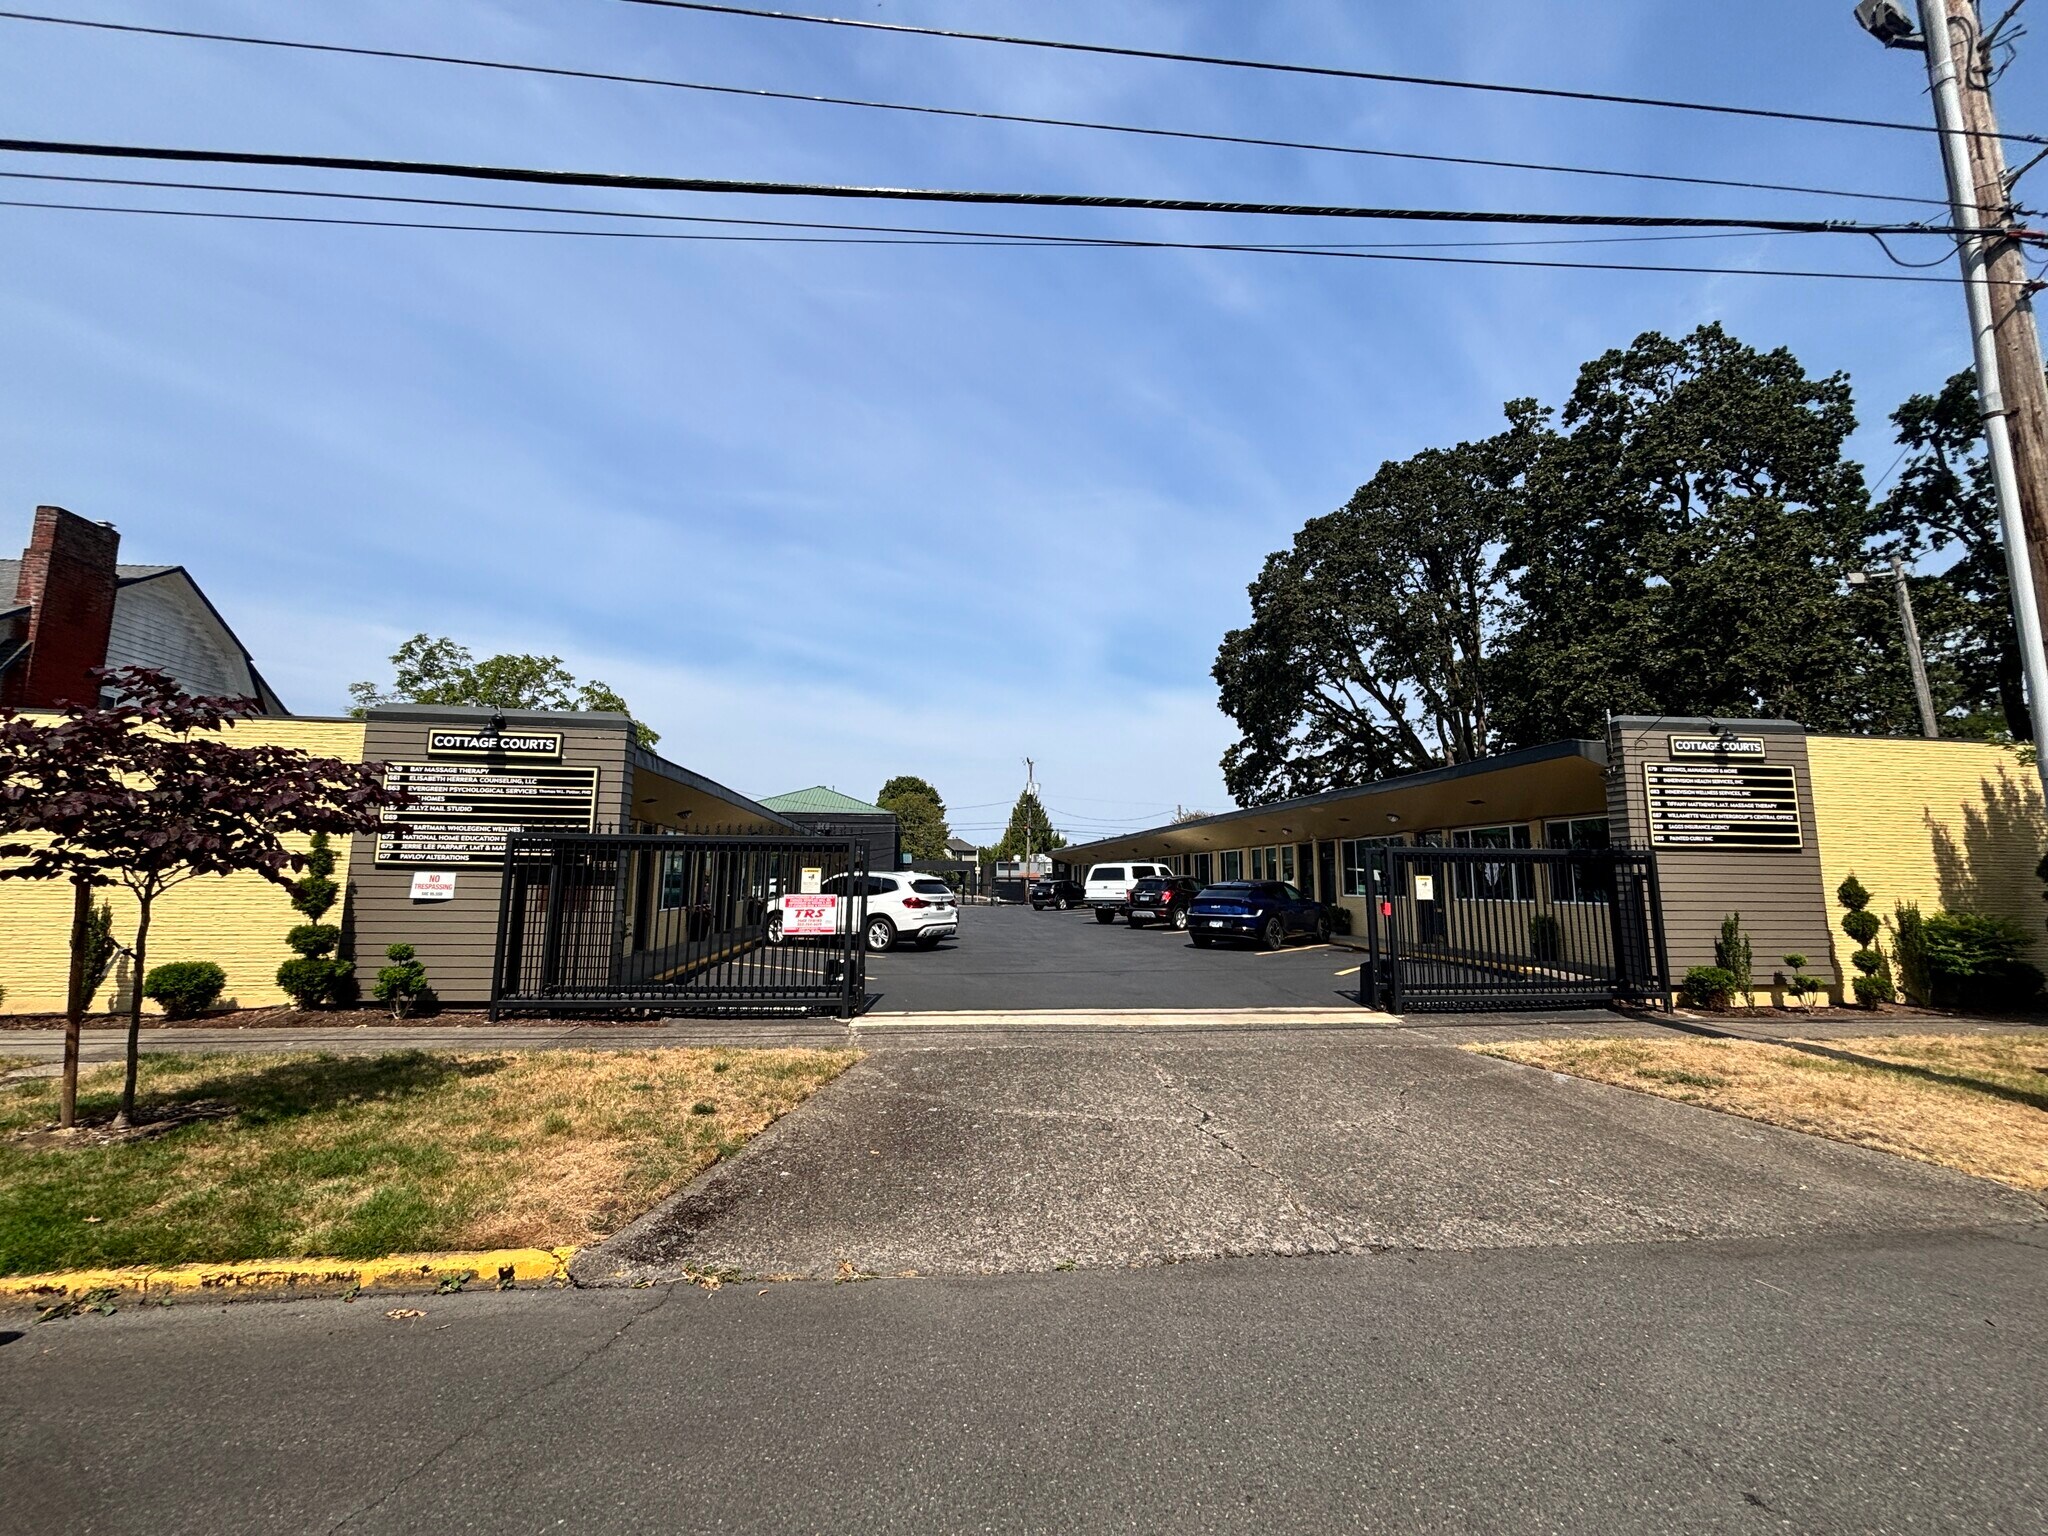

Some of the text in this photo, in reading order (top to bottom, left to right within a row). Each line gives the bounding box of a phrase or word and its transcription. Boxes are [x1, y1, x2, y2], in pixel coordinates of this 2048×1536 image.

[434, 735, 555, 750] COTTAGE COURTS
[1675, 741, 1761, 752] COTTAGE COURTS
[449, 786, 505, 794] PSYCHOLOGICAL
[447, 825, 492, 833] WHOLEGENIC
[429, 874, 441, 883] NO
[414, 883, 453, 891] TRESPASSING
[794, 909, 826, 919] TRS
